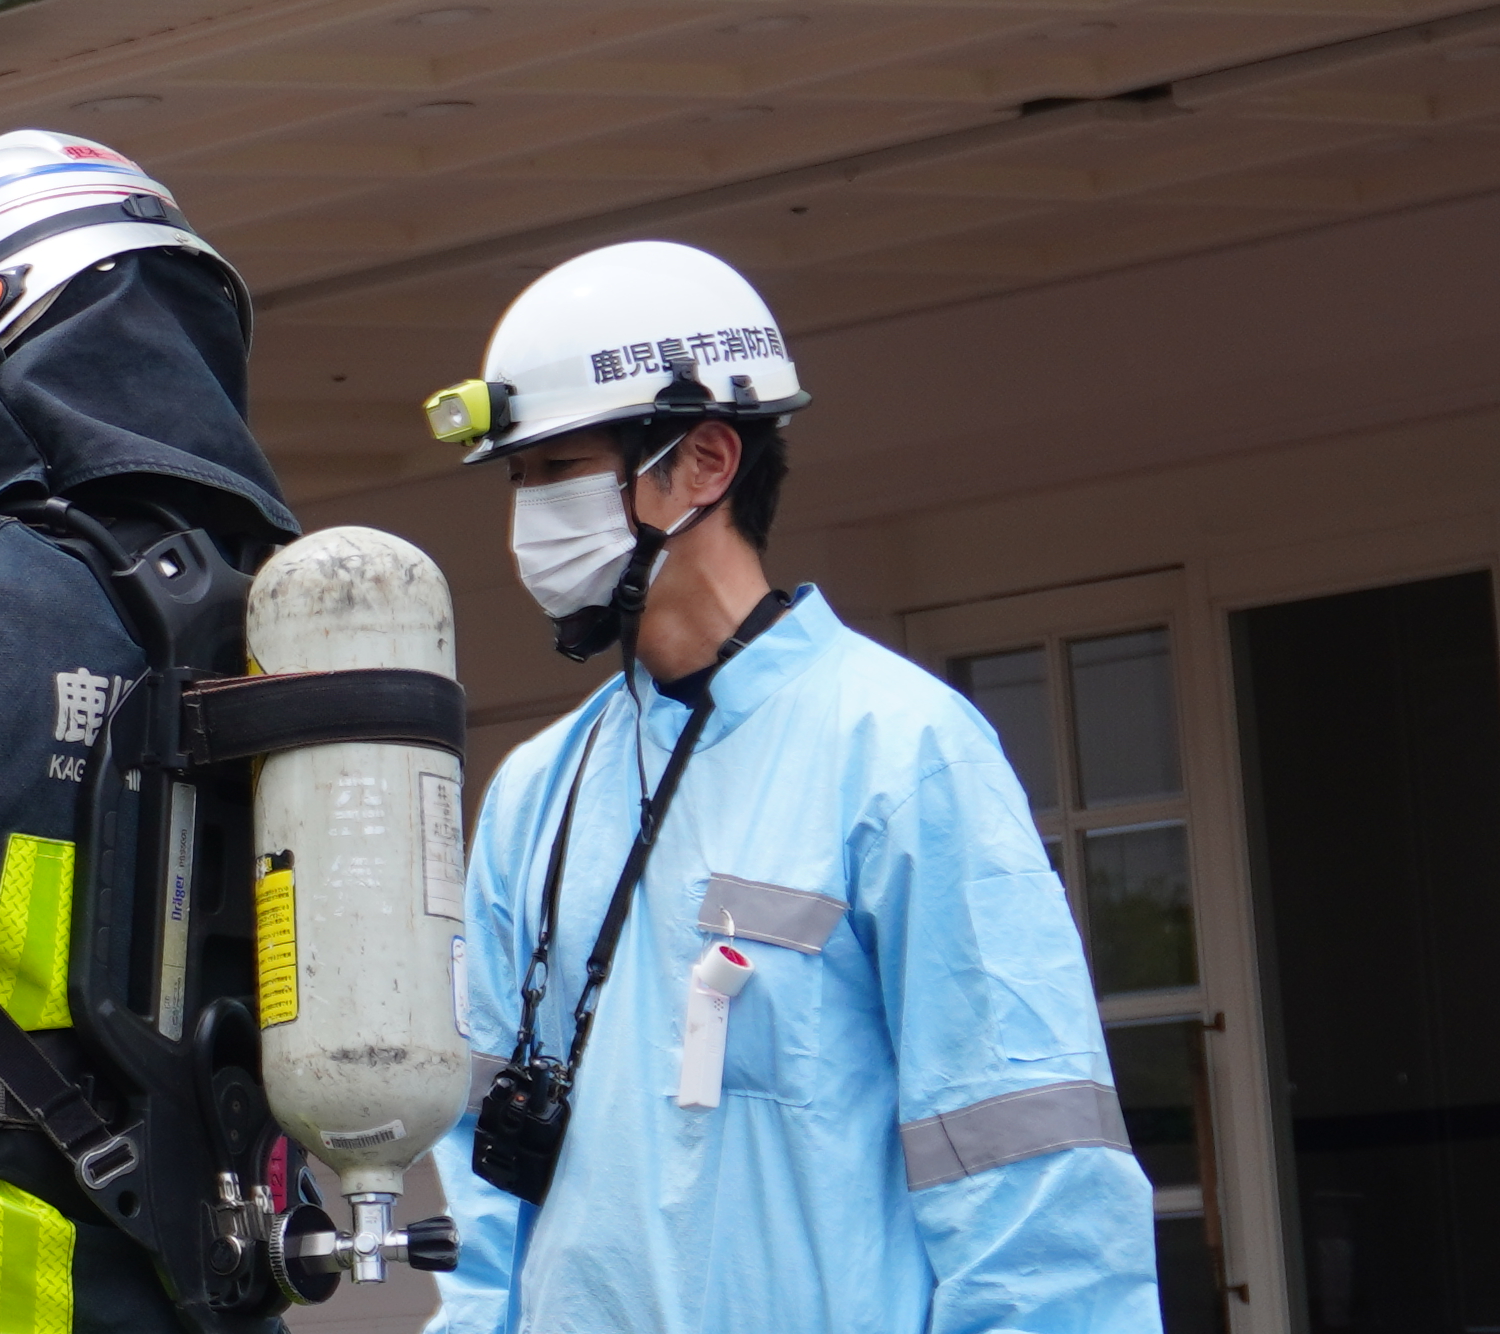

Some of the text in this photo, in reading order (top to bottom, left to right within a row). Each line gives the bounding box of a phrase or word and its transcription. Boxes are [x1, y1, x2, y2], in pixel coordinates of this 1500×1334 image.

[591, 326, 784, 385] 鹿児島市消防局
[171, 874, 186, 922] Dräger
